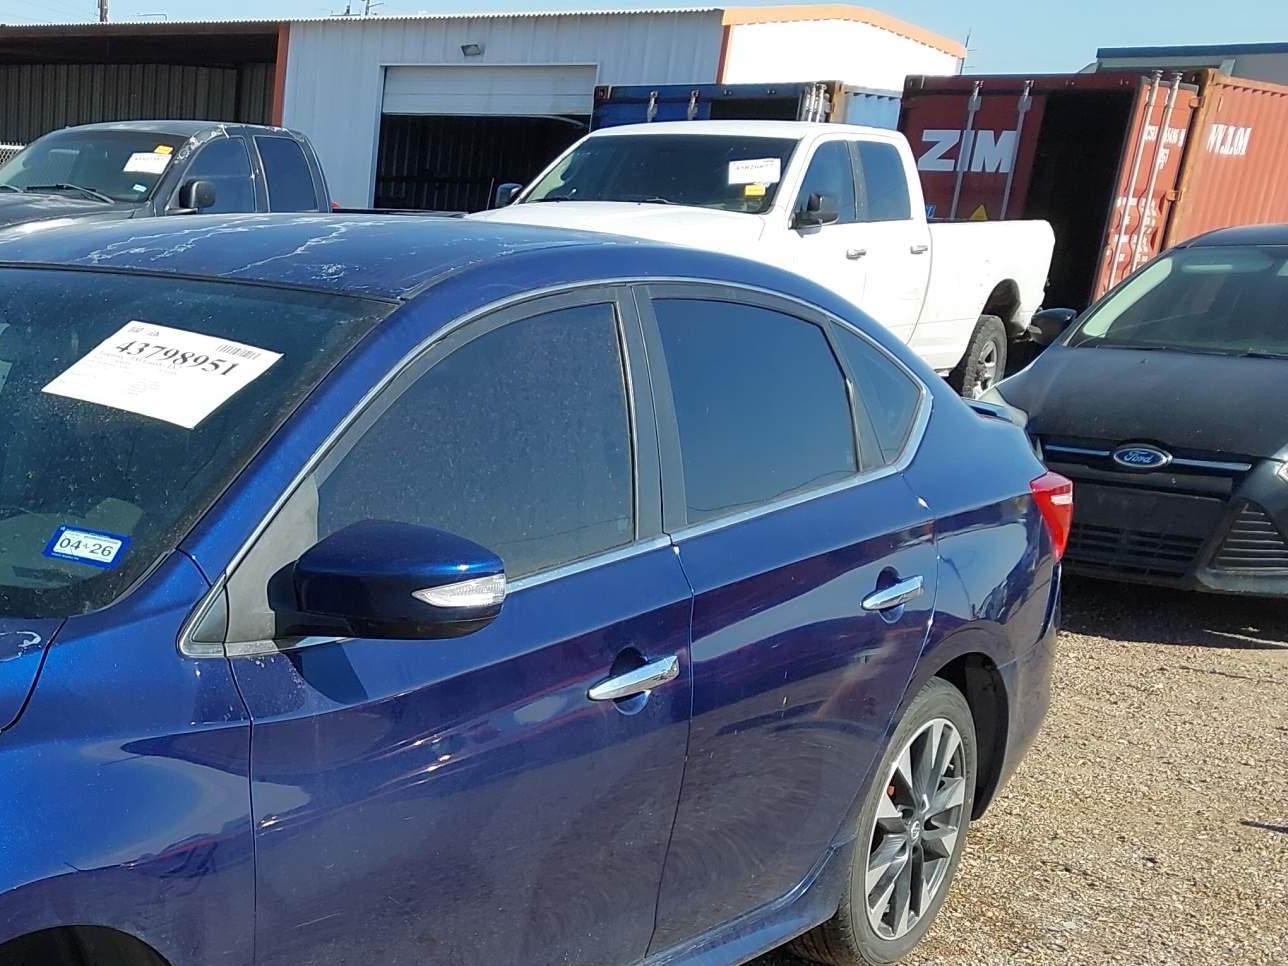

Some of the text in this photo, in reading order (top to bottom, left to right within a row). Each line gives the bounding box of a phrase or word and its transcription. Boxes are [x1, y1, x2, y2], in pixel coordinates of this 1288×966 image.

[918, 129, 1017, 172] ZIM
[116, 340, 239, 376] 43798951
[1123, 450, 1155, 464] Ford
